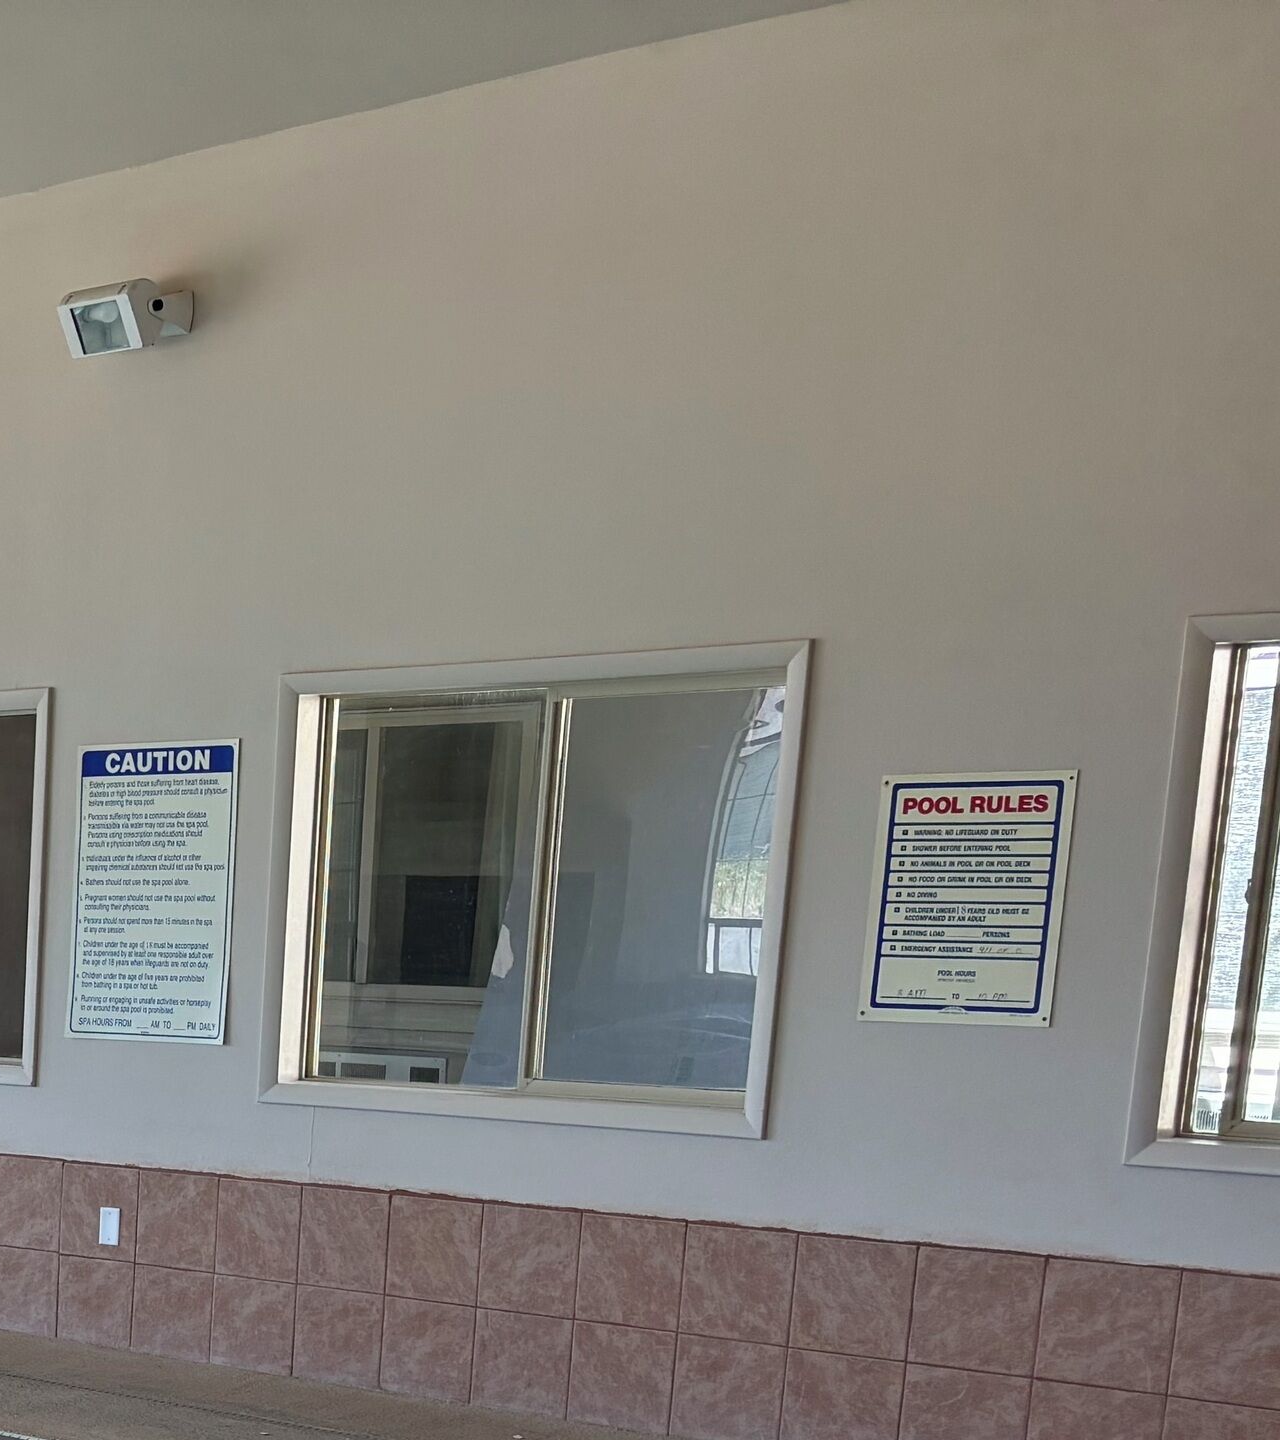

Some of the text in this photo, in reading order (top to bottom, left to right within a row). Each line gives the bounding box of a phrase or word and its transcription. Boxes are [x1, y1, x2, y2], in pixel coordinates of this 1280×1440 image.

[104, 749, 210, 773] CAUTION
[902, 795, 1050, 815] POOL RULES
[79, 1017, 91, 1026] SPA
[92, 1018, 114, 1027] HOURS
[115, 1019, 132, 1027] FROM
[163, 1021, 171, 1029] TO
[187, 1022, 196, 1030] PM
